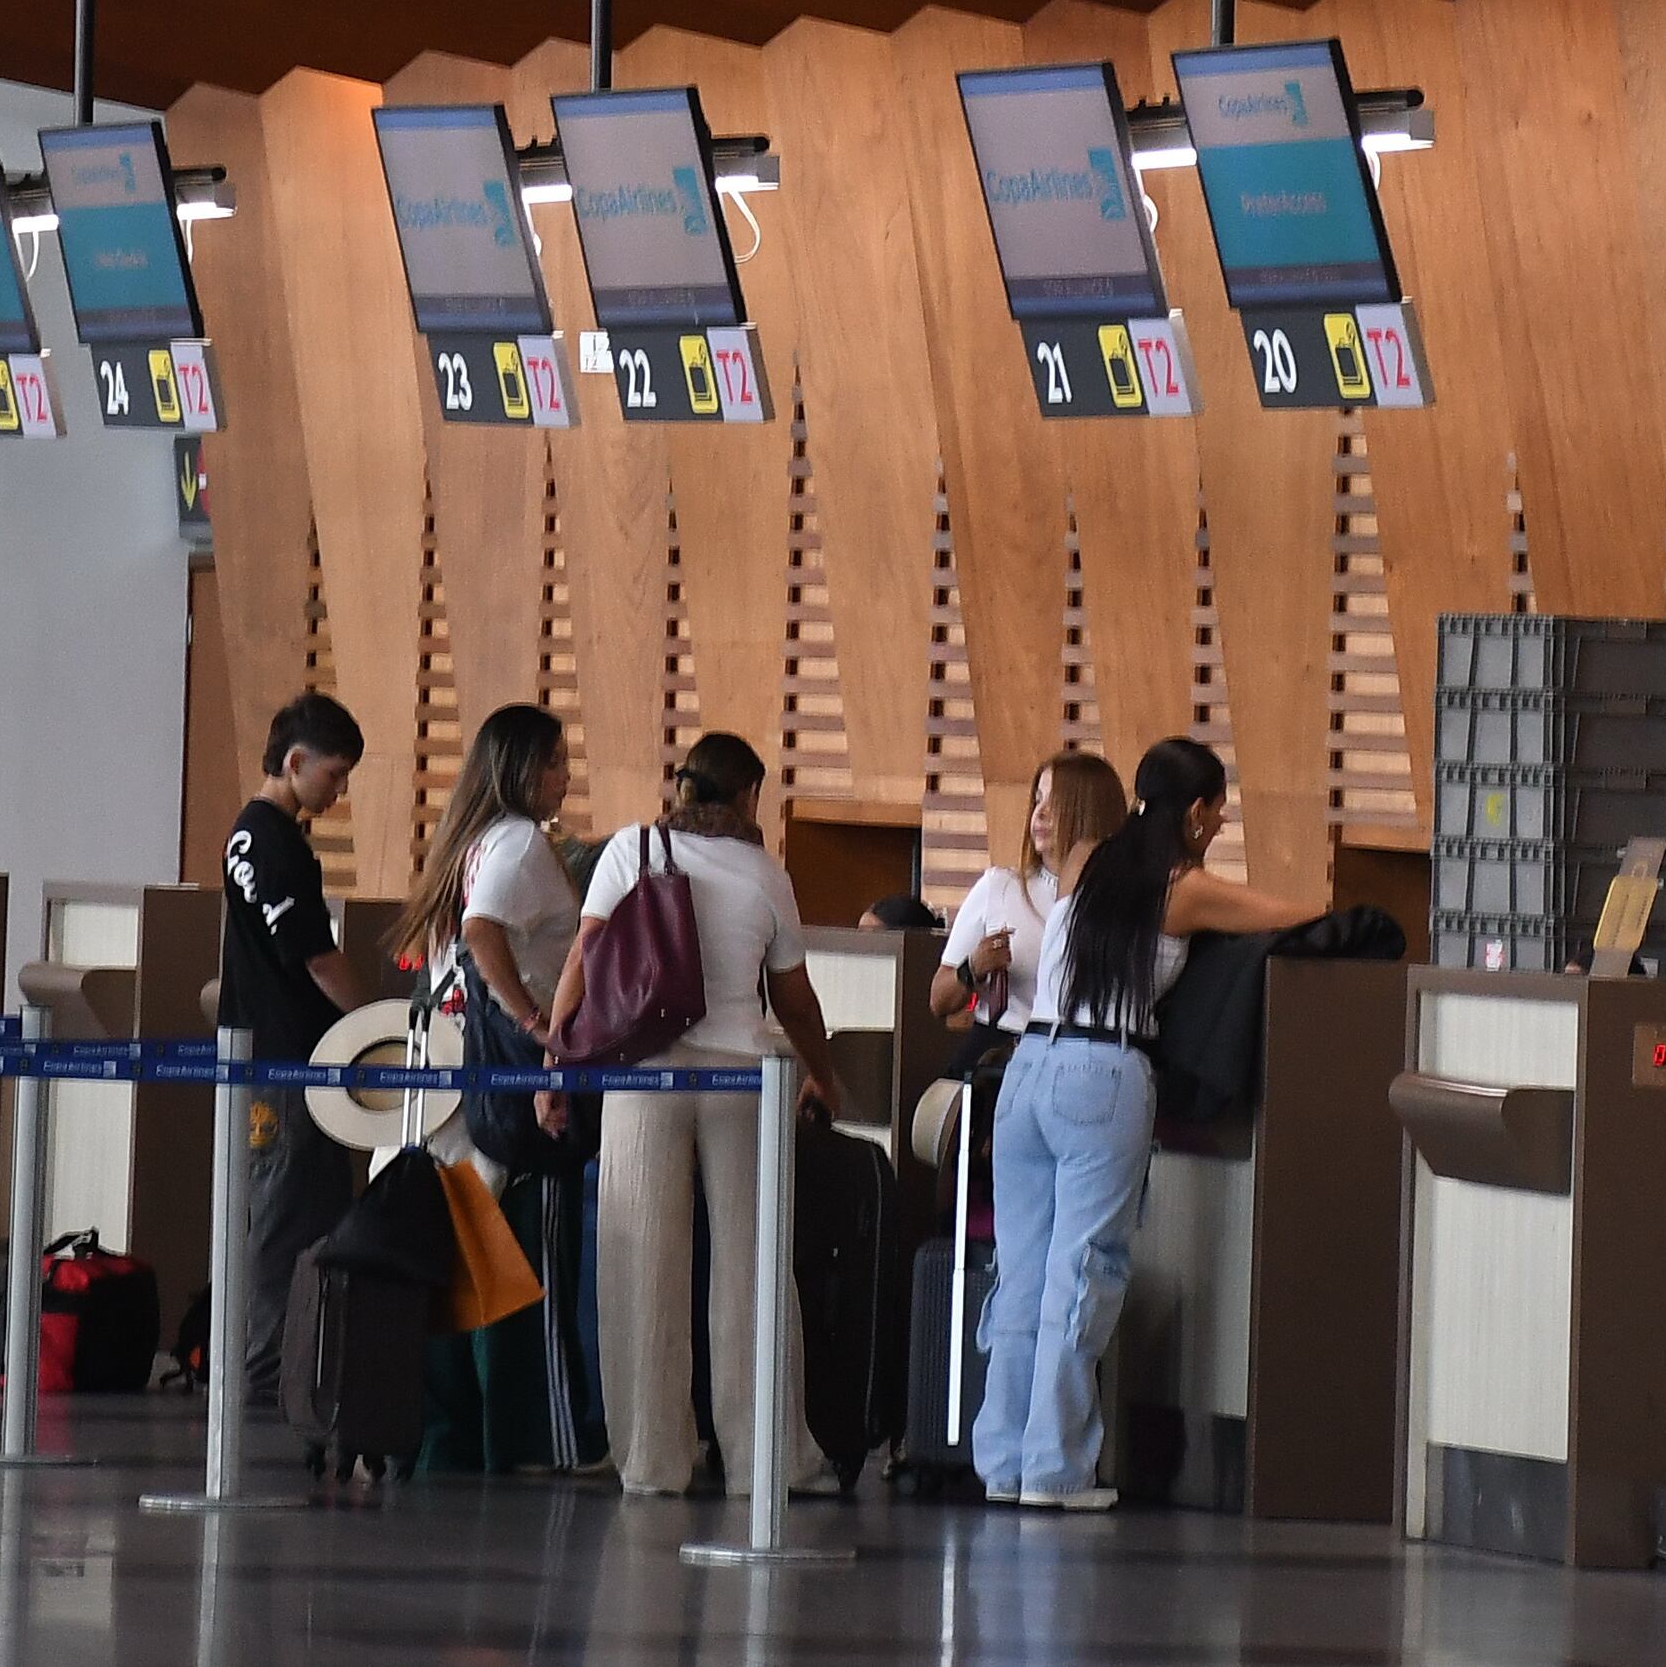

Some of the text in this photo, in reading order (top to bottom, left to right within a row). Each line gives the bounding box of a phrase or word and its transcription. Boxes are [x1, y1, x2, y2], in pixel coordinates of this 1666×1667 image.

[99, 361, 210, 416] 24 T2
[438, 351, 561, 411] 23 T2
[619, 348, 657, 408] 22
[715, 350, 754, 404] T2
[1037, 338, 1180, 404] 21 T2
[1253, 327, 1411, 394] 20 T2
[16, 372, 49, 422] T2
